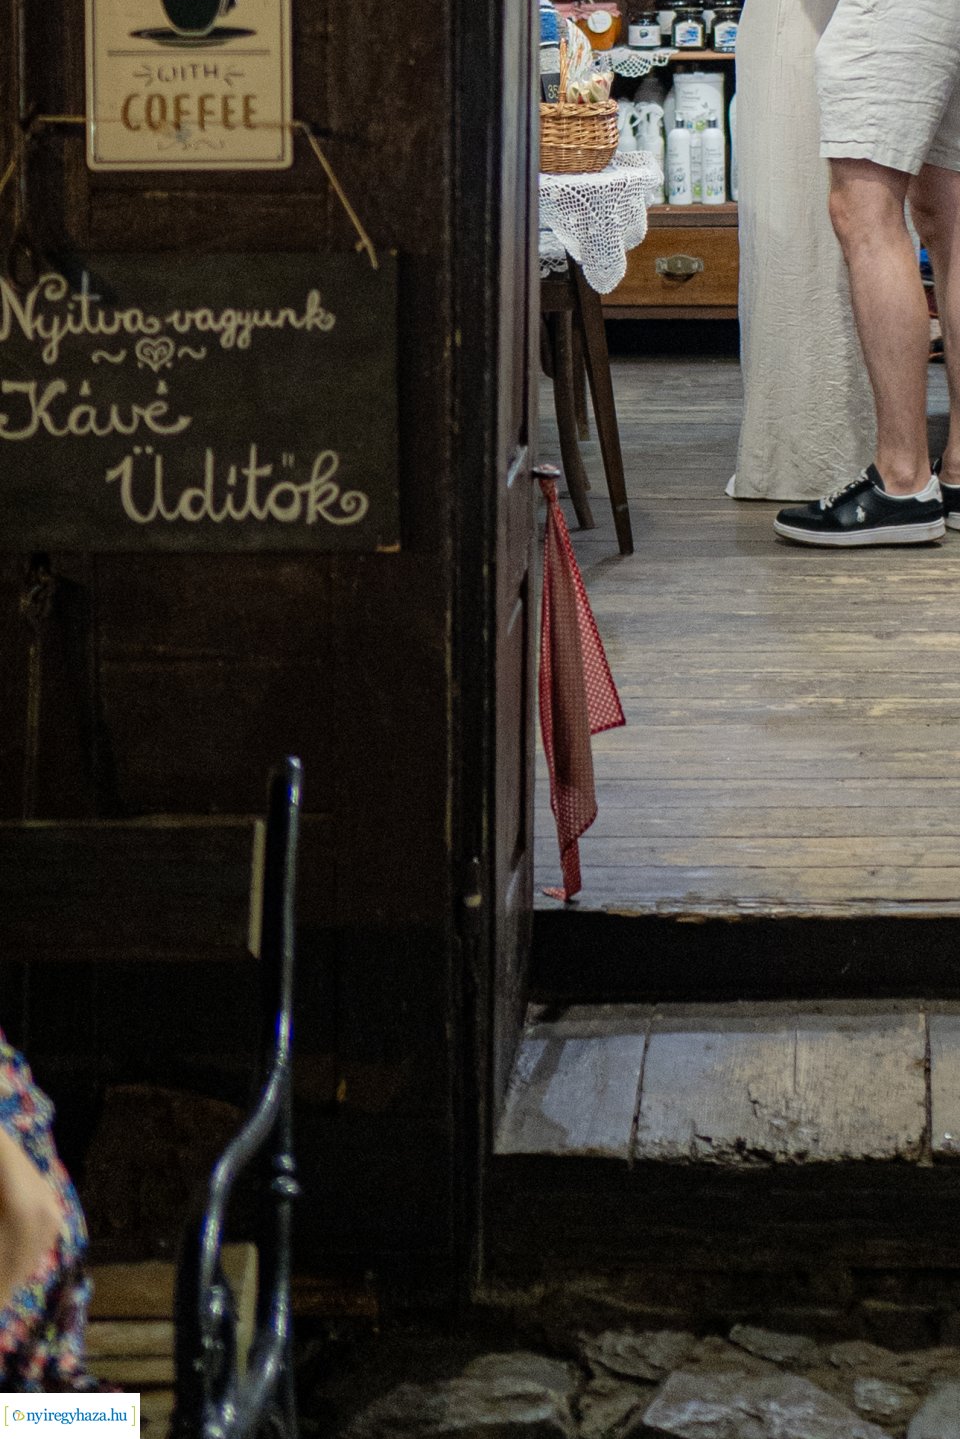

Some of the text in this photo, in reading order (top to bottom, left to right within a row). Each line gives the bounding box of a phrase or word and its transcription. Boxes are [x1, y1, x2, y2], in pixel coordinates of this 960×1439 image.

[157, 63, 219, 83] WITH
[120, 92, 259, 134] COFFEE
[0, 271, 337, 365] Nyitva vagyunk
[0, 379, 194, 440] Kávé
